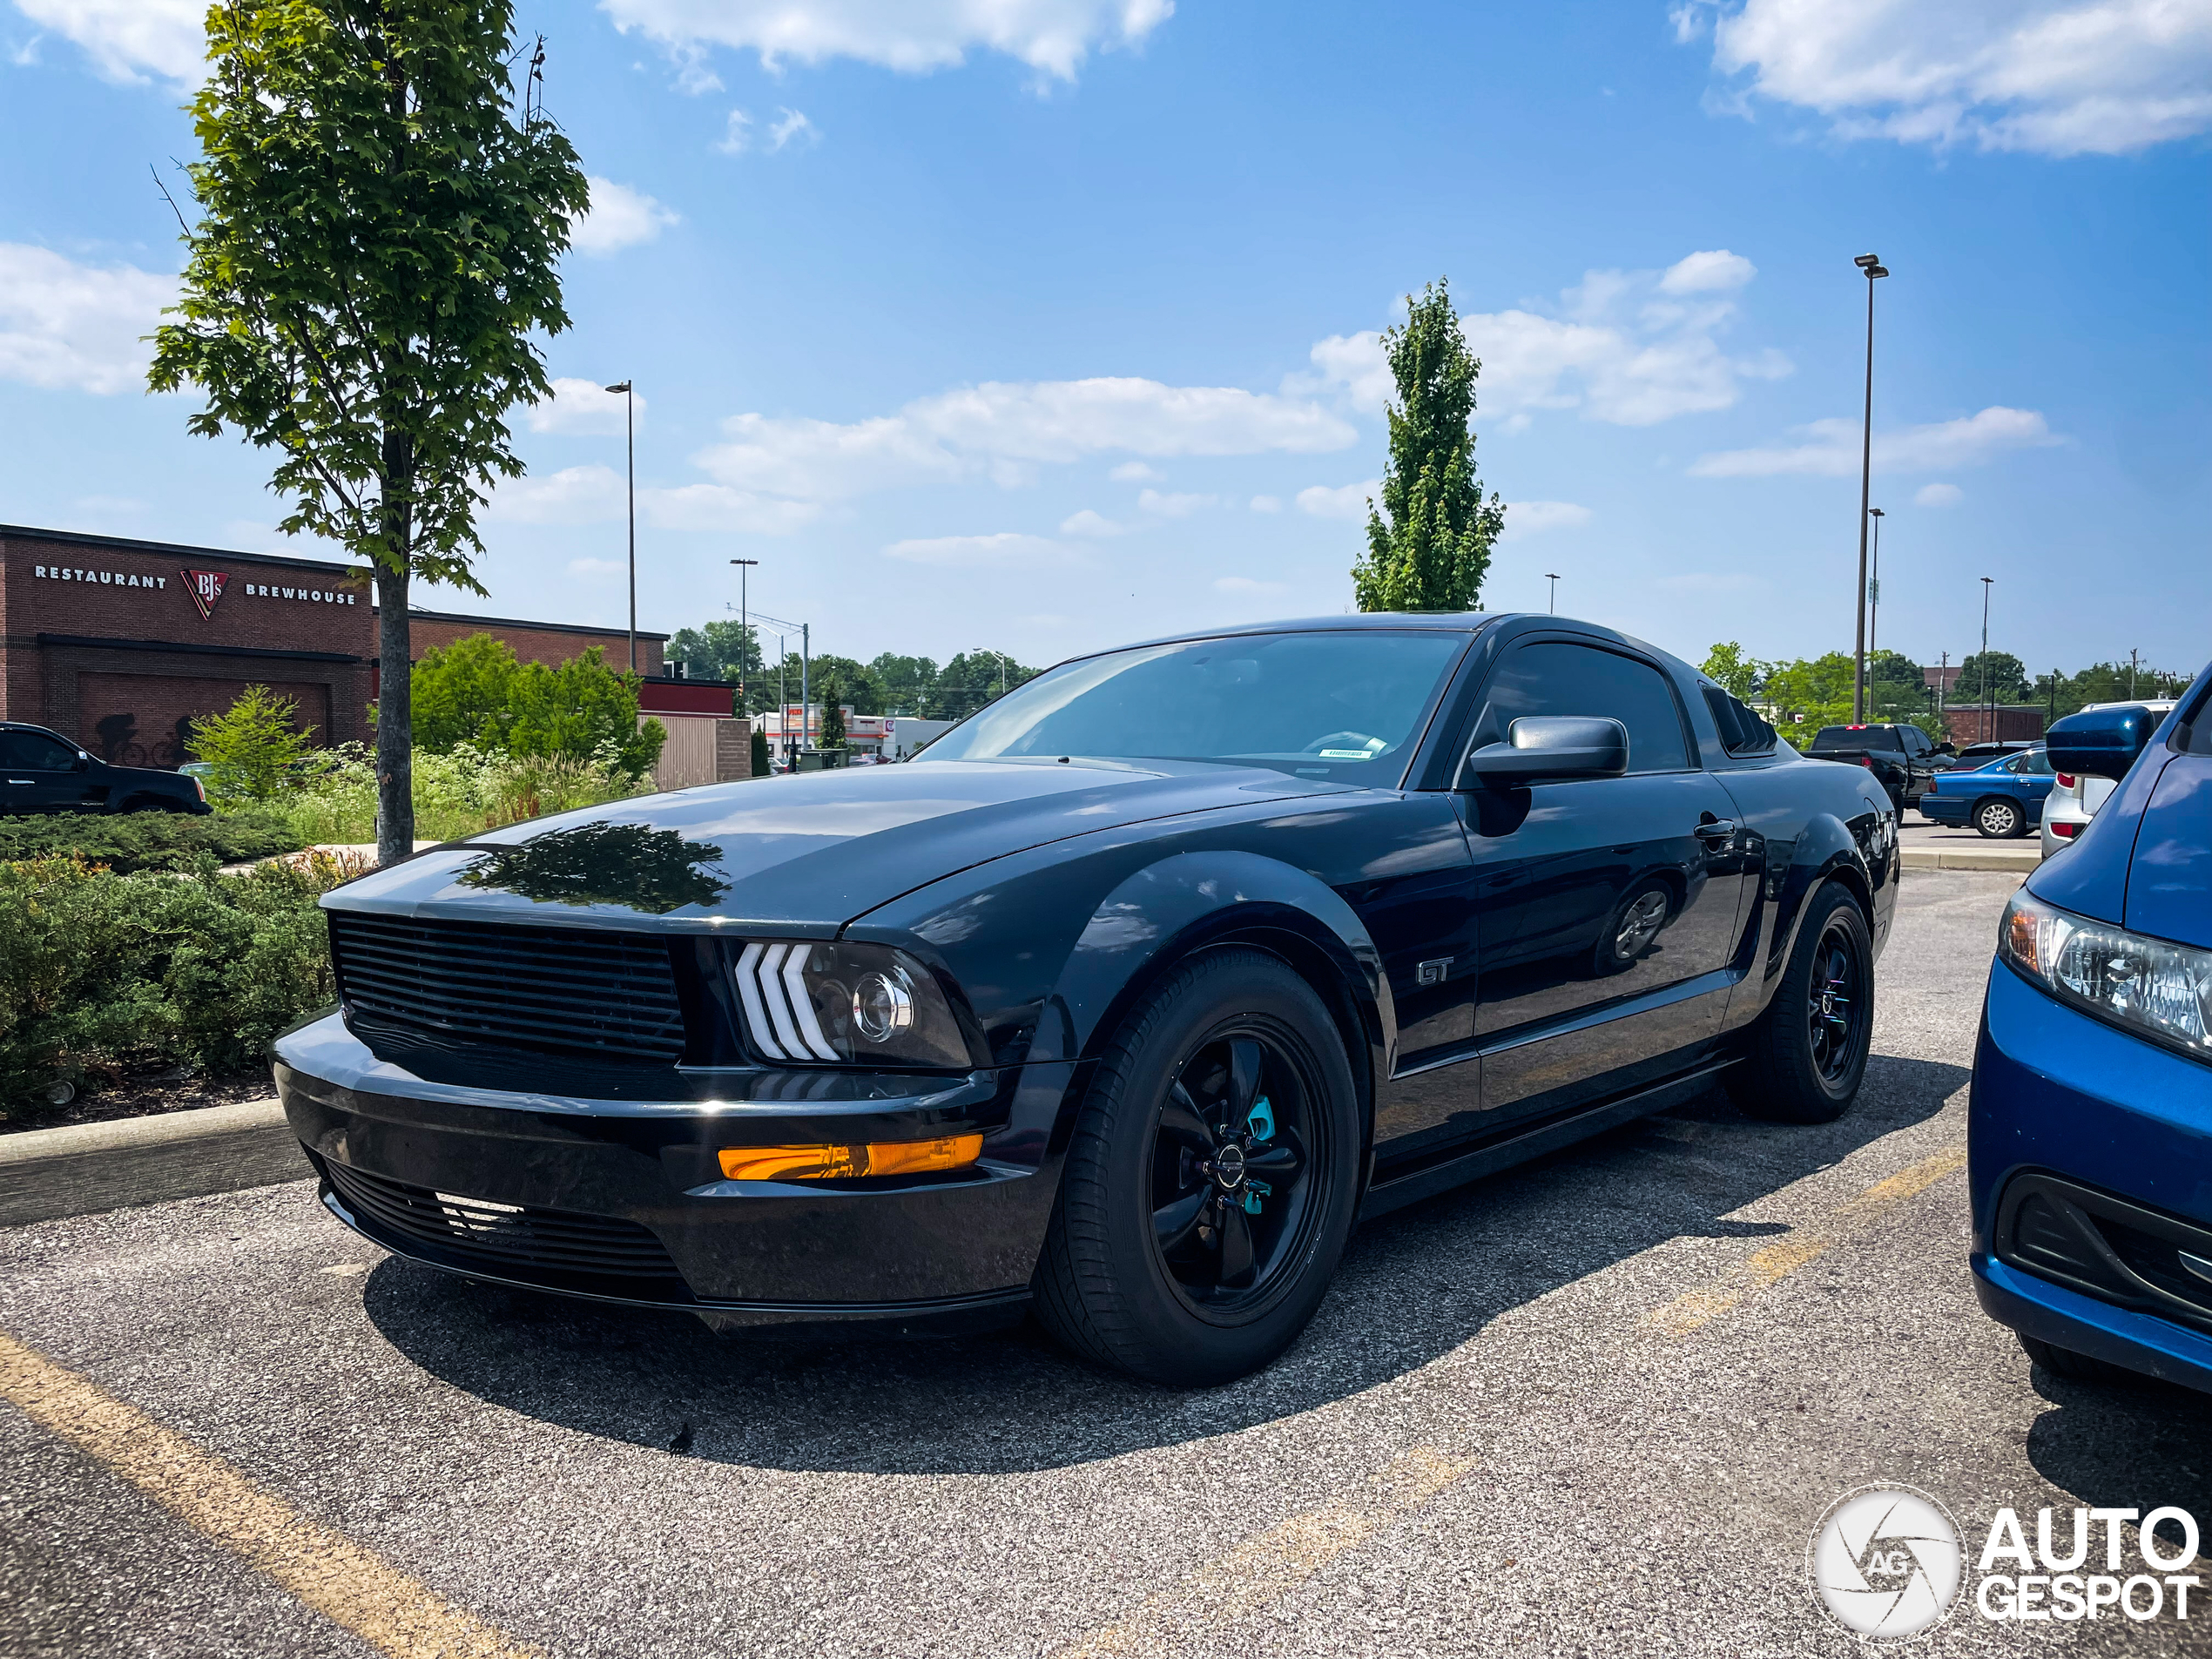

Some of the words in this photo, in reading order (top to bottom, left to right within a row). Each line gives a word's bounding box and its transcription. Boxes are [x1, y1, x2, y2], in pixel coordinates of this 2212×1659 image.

[35, 565, 166, 589] RESTAURANT
[198, 573, 222, 602] BJ's
[246, 583, 355, 605] BREWHOUSE
[1416, 956, 1454, 986] GT
